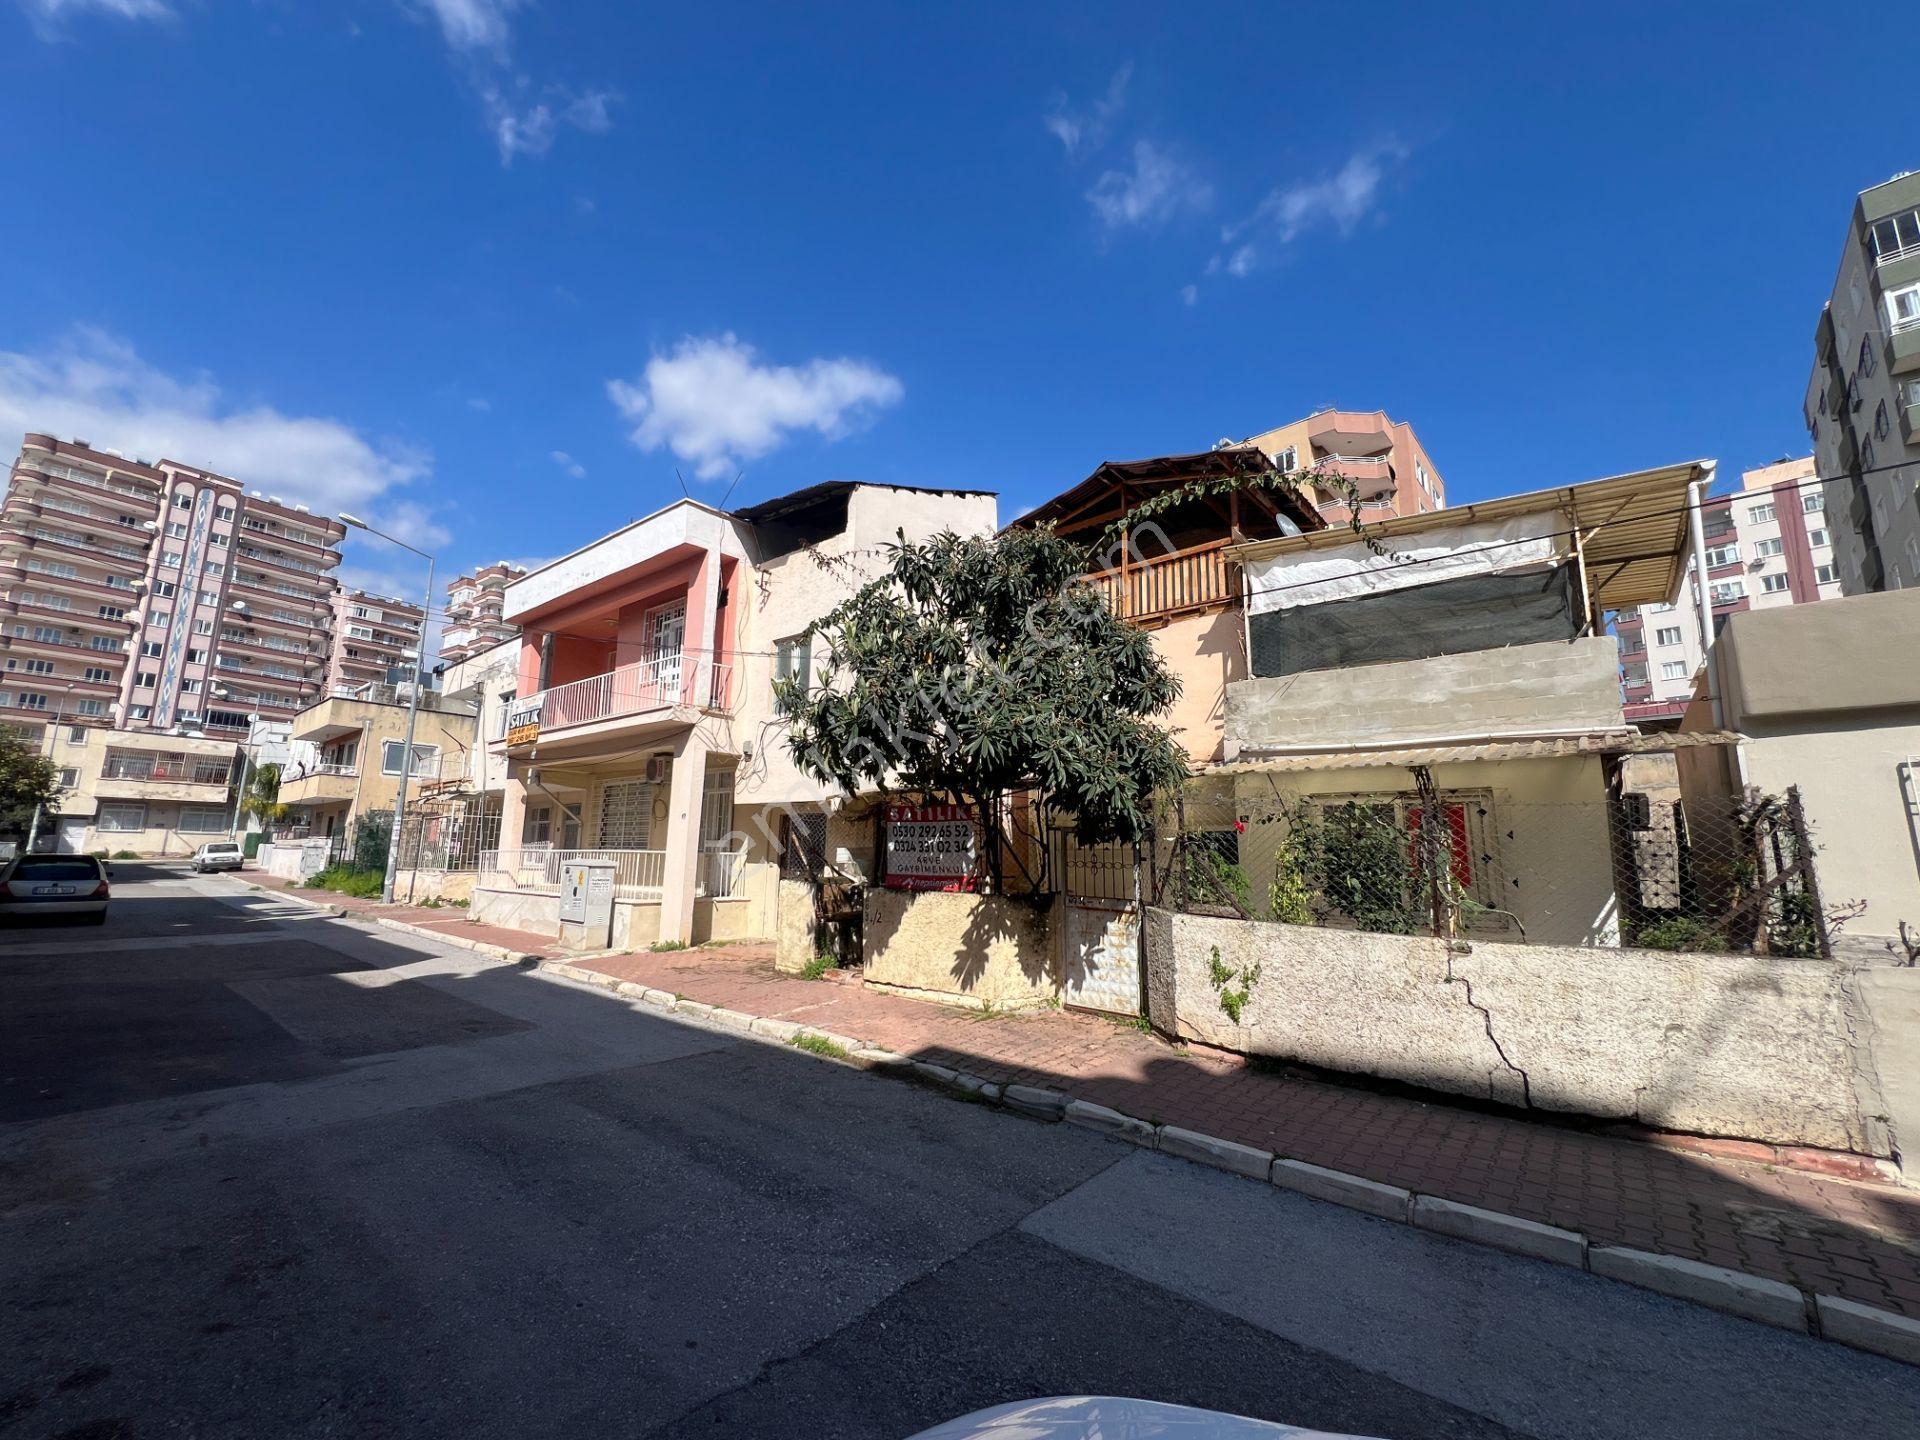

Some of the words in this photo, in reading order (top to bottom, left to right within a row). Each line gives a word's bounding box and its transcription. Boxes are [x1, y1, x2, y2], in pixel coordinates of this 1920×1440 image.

[890, 806, 968, 821] SATILIK
[893, 826, 915, 837] 0530
[919, 826, 937, 838] 292
[955, 825, 968, 837] 52
[895, 840, 916, 852] 0324
[937, 841, 951, 853] 02
[954, 840, 968, 853] 34
[917, 856, 941, 865] ARVE
